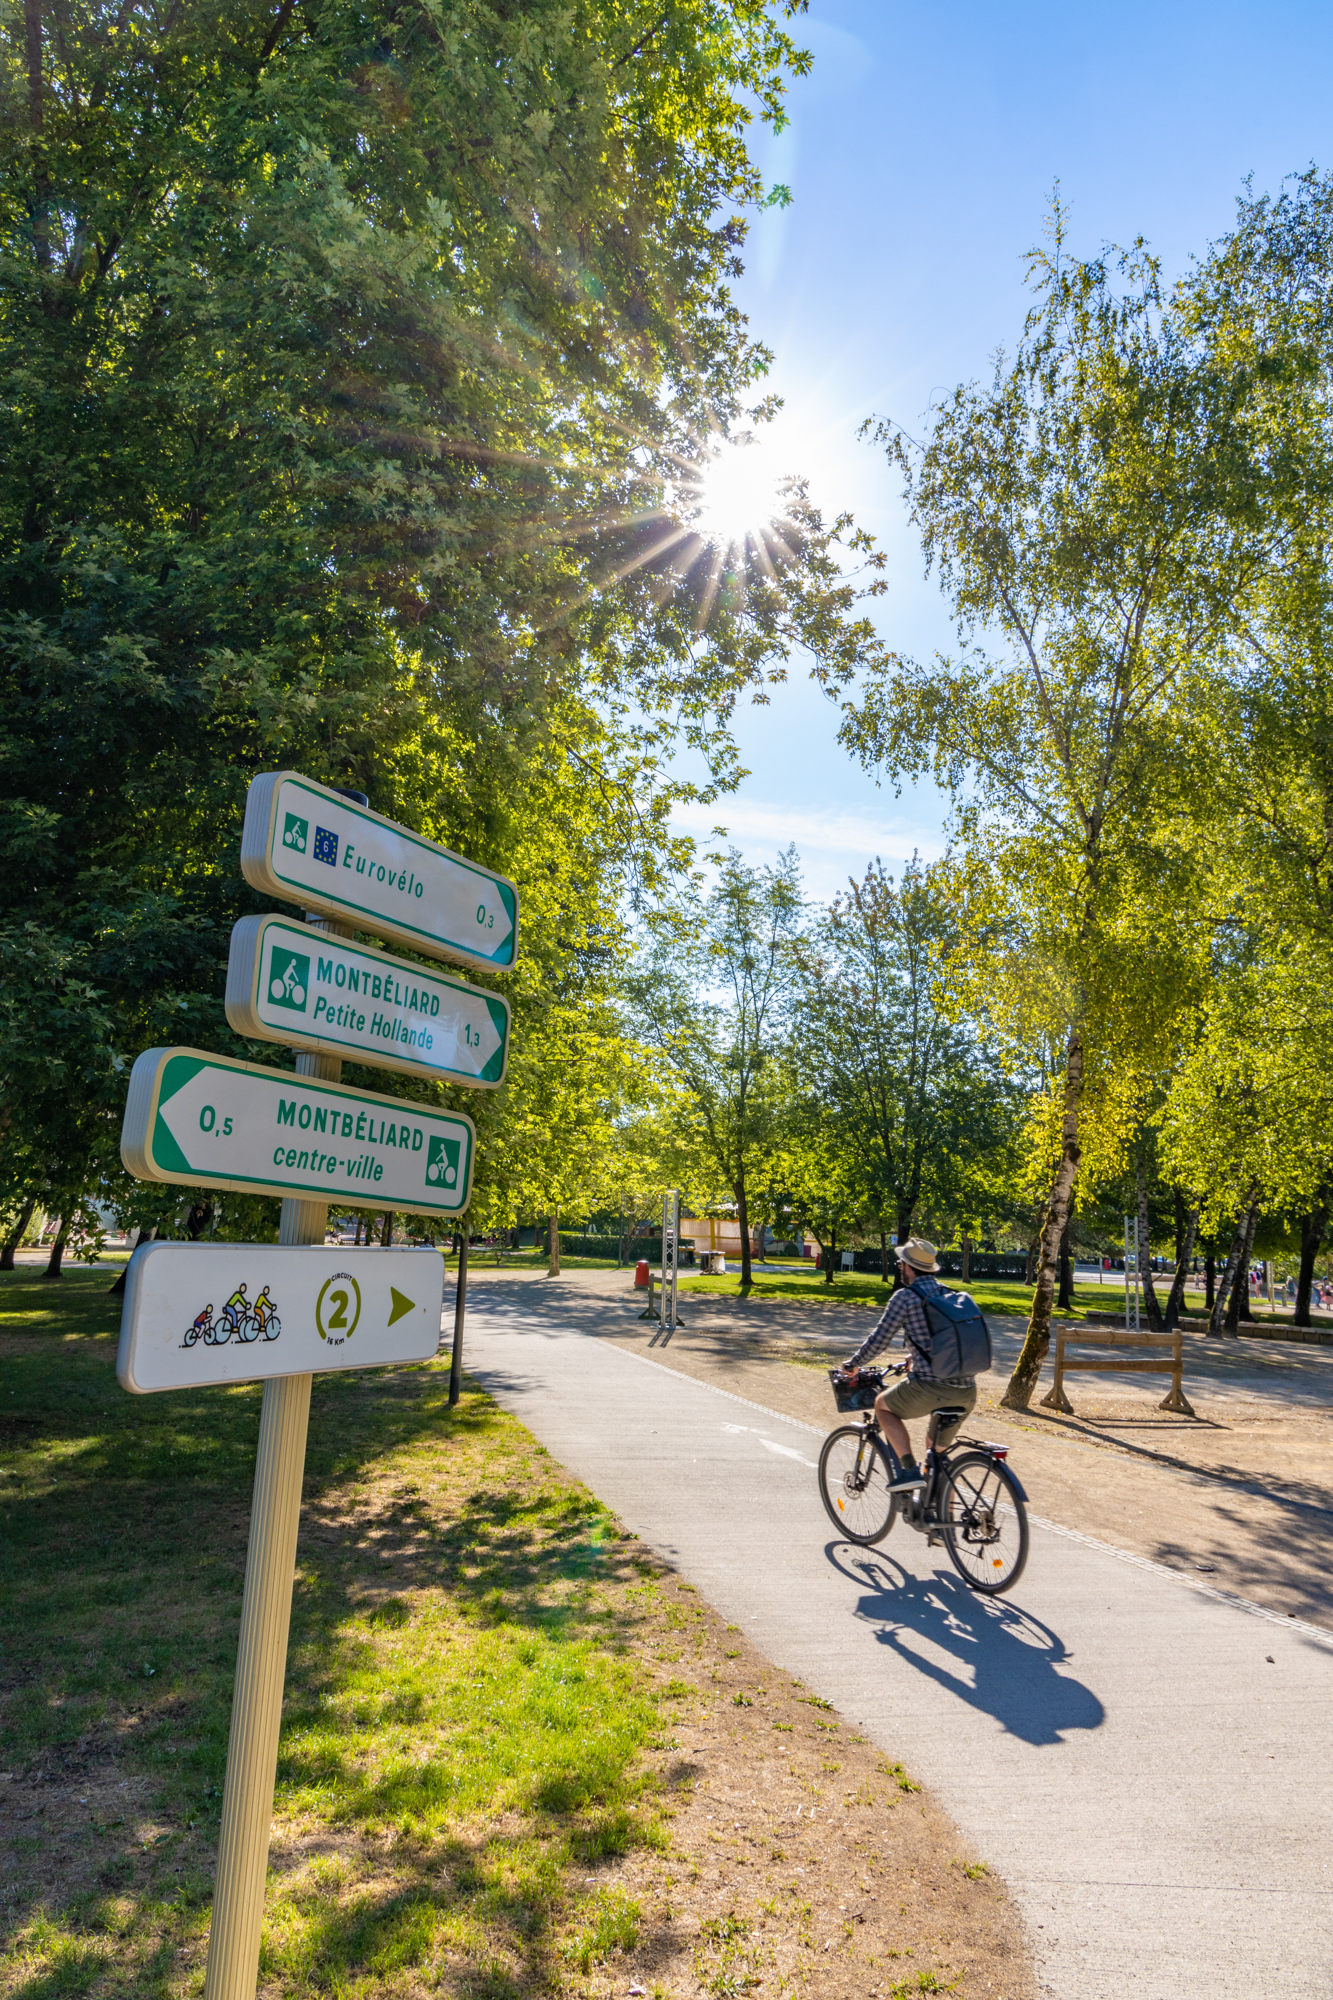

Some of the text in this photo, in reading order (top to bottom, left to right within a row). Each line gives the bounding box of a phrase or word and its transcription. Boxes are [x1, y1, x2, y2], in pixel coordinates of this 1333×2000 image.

[323, 840, 329, 853] 6
[342, 844, 424, 898] Eurovélo
[476, 904, 494, 929] 0,3
[316, 957, 440, 1017] MONTBÉLIARD
[313, 996, 433, 1050] Petite Hollande
[464, 1023, 480, 1048] 1,3
[199, 1104, 233, 1138] 0,5
[276, 1099, 424, 1152] MONTBÉLIARD
[273, 1147, 384, 1182] centre-ville
[331, 1272, 353, 1282] CIRCUIT
[328, 1289, 349, 1329] 2
[326, 1336, 345, 1346] 16 Km
